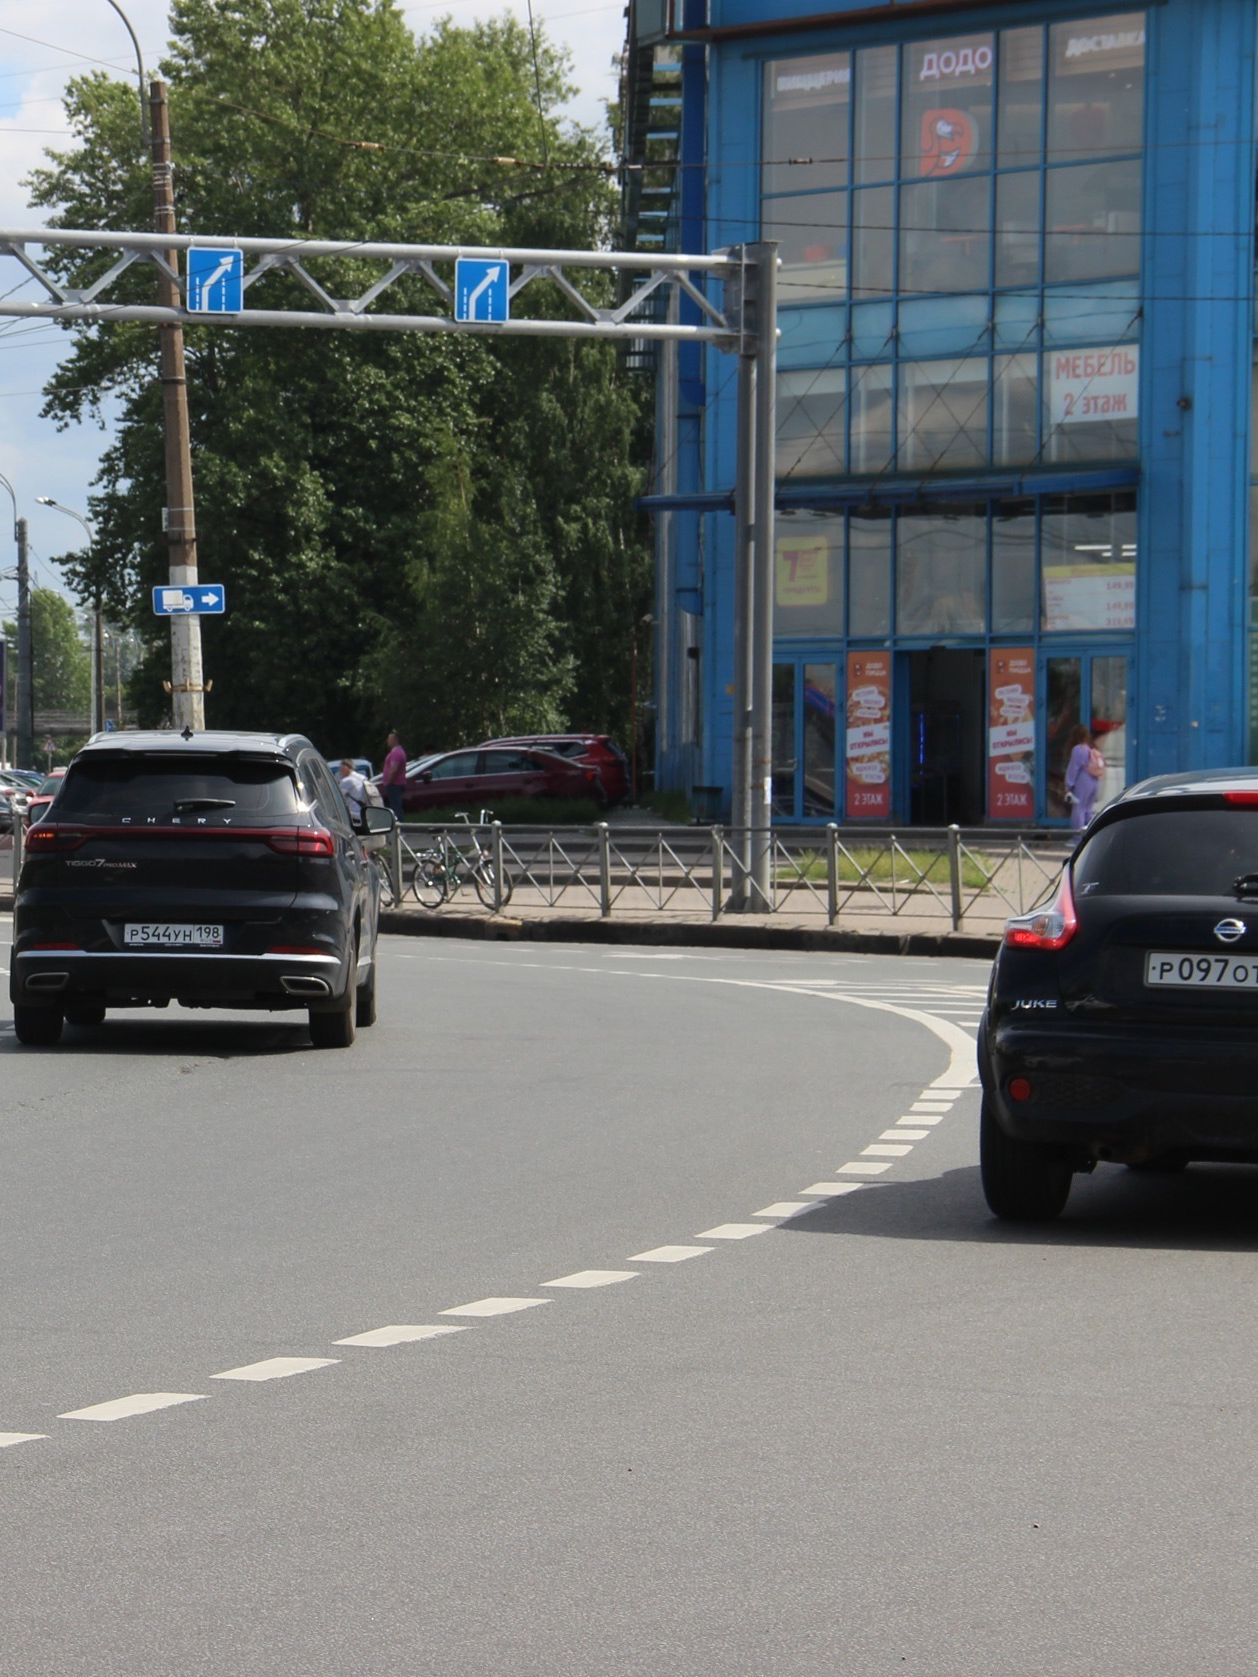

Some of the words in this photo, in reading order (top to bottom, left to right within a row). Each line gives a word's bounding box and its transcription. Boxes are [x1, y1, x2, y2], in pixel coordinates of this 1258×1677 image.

[920, 47, 991, 80] ДОДО
[1055, 351, 1136, 380] МЕБЕЛЬ
[1064, 392, 1074, 416] 2
[1082, 394, 1127, 415] этаж
[854, 793, 860, 805] 2
[862, 793, 883, 805] ЭТАЖ
[997, 793, 1003, 806] 2
[1005, 793, 1027, 806] ЭТАЖ
[122, 817, 232, 825] CHERY
[1011, 999, 1058, 1011] JUKE
